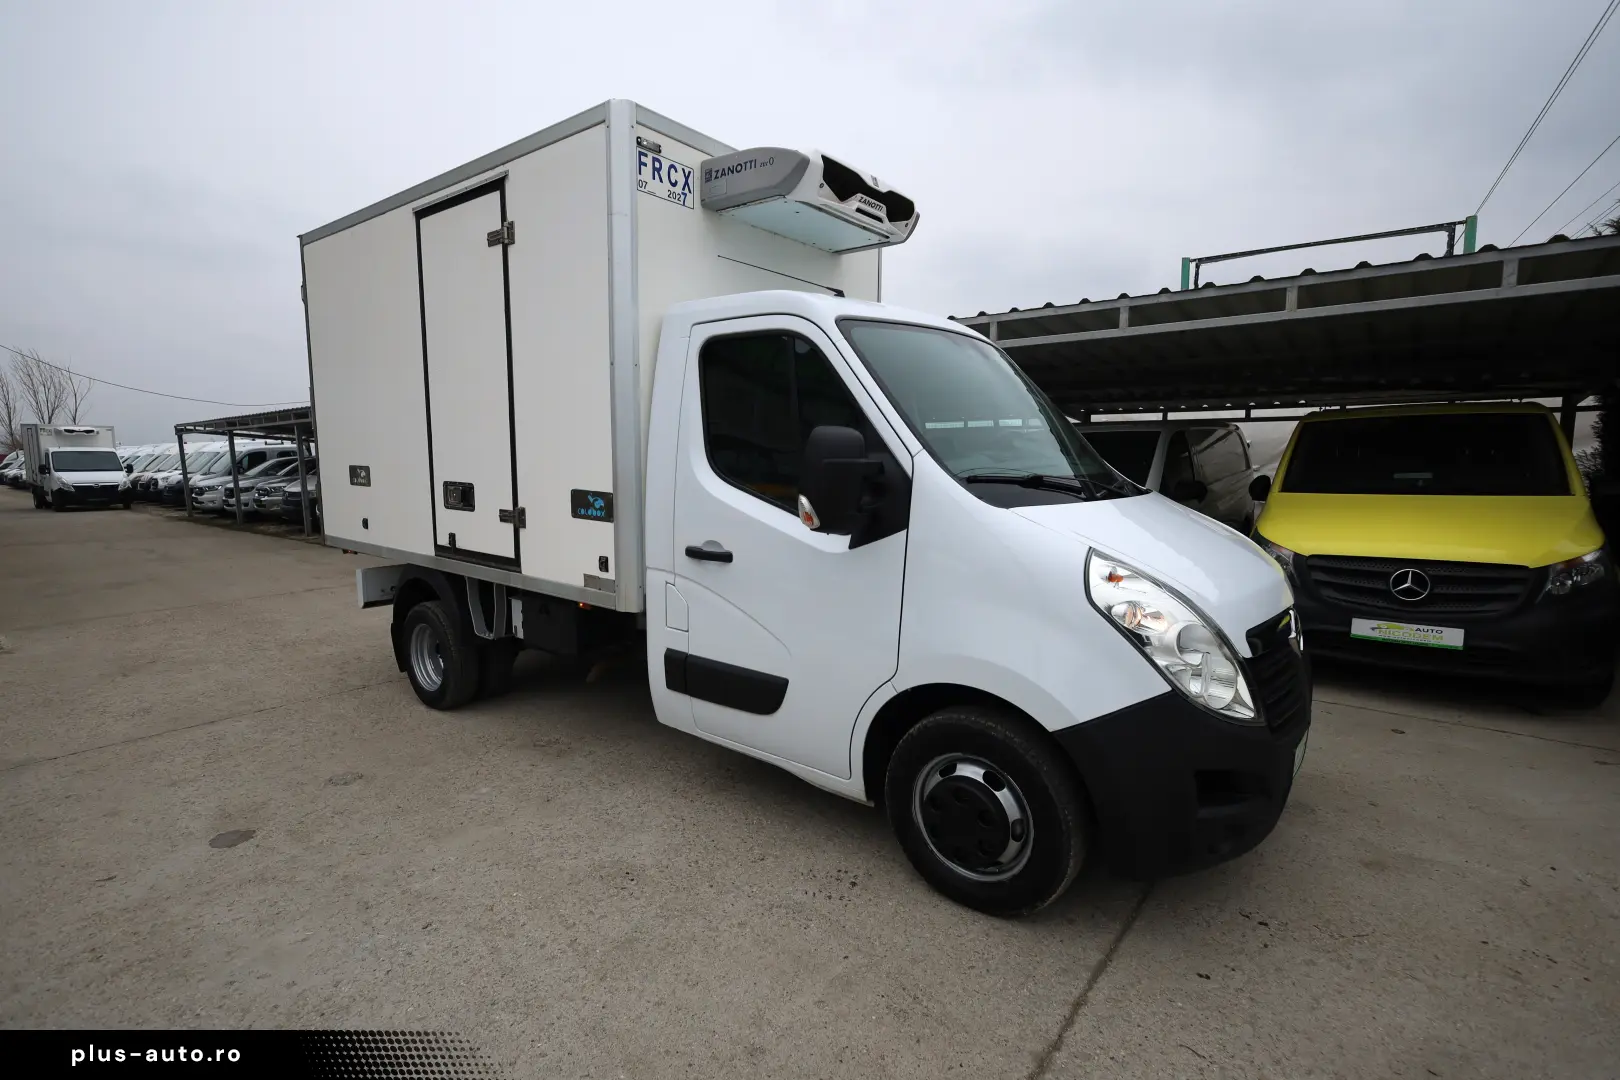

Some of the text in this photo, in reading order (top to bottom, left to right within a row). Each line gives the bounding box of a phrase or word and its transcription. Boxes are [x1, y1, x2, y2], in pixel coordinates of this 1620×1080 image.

[638, 150, 692, 194] FRCX
[713, 158, 757, 181] ZANOTTI
[638, 179, 688, 206] 07 2027
[858, 196, 884, 212] ZANOTTI
[1378, 629, 1443, 641] NICODEM
[1415, 627, 1443, 635] AUTO
